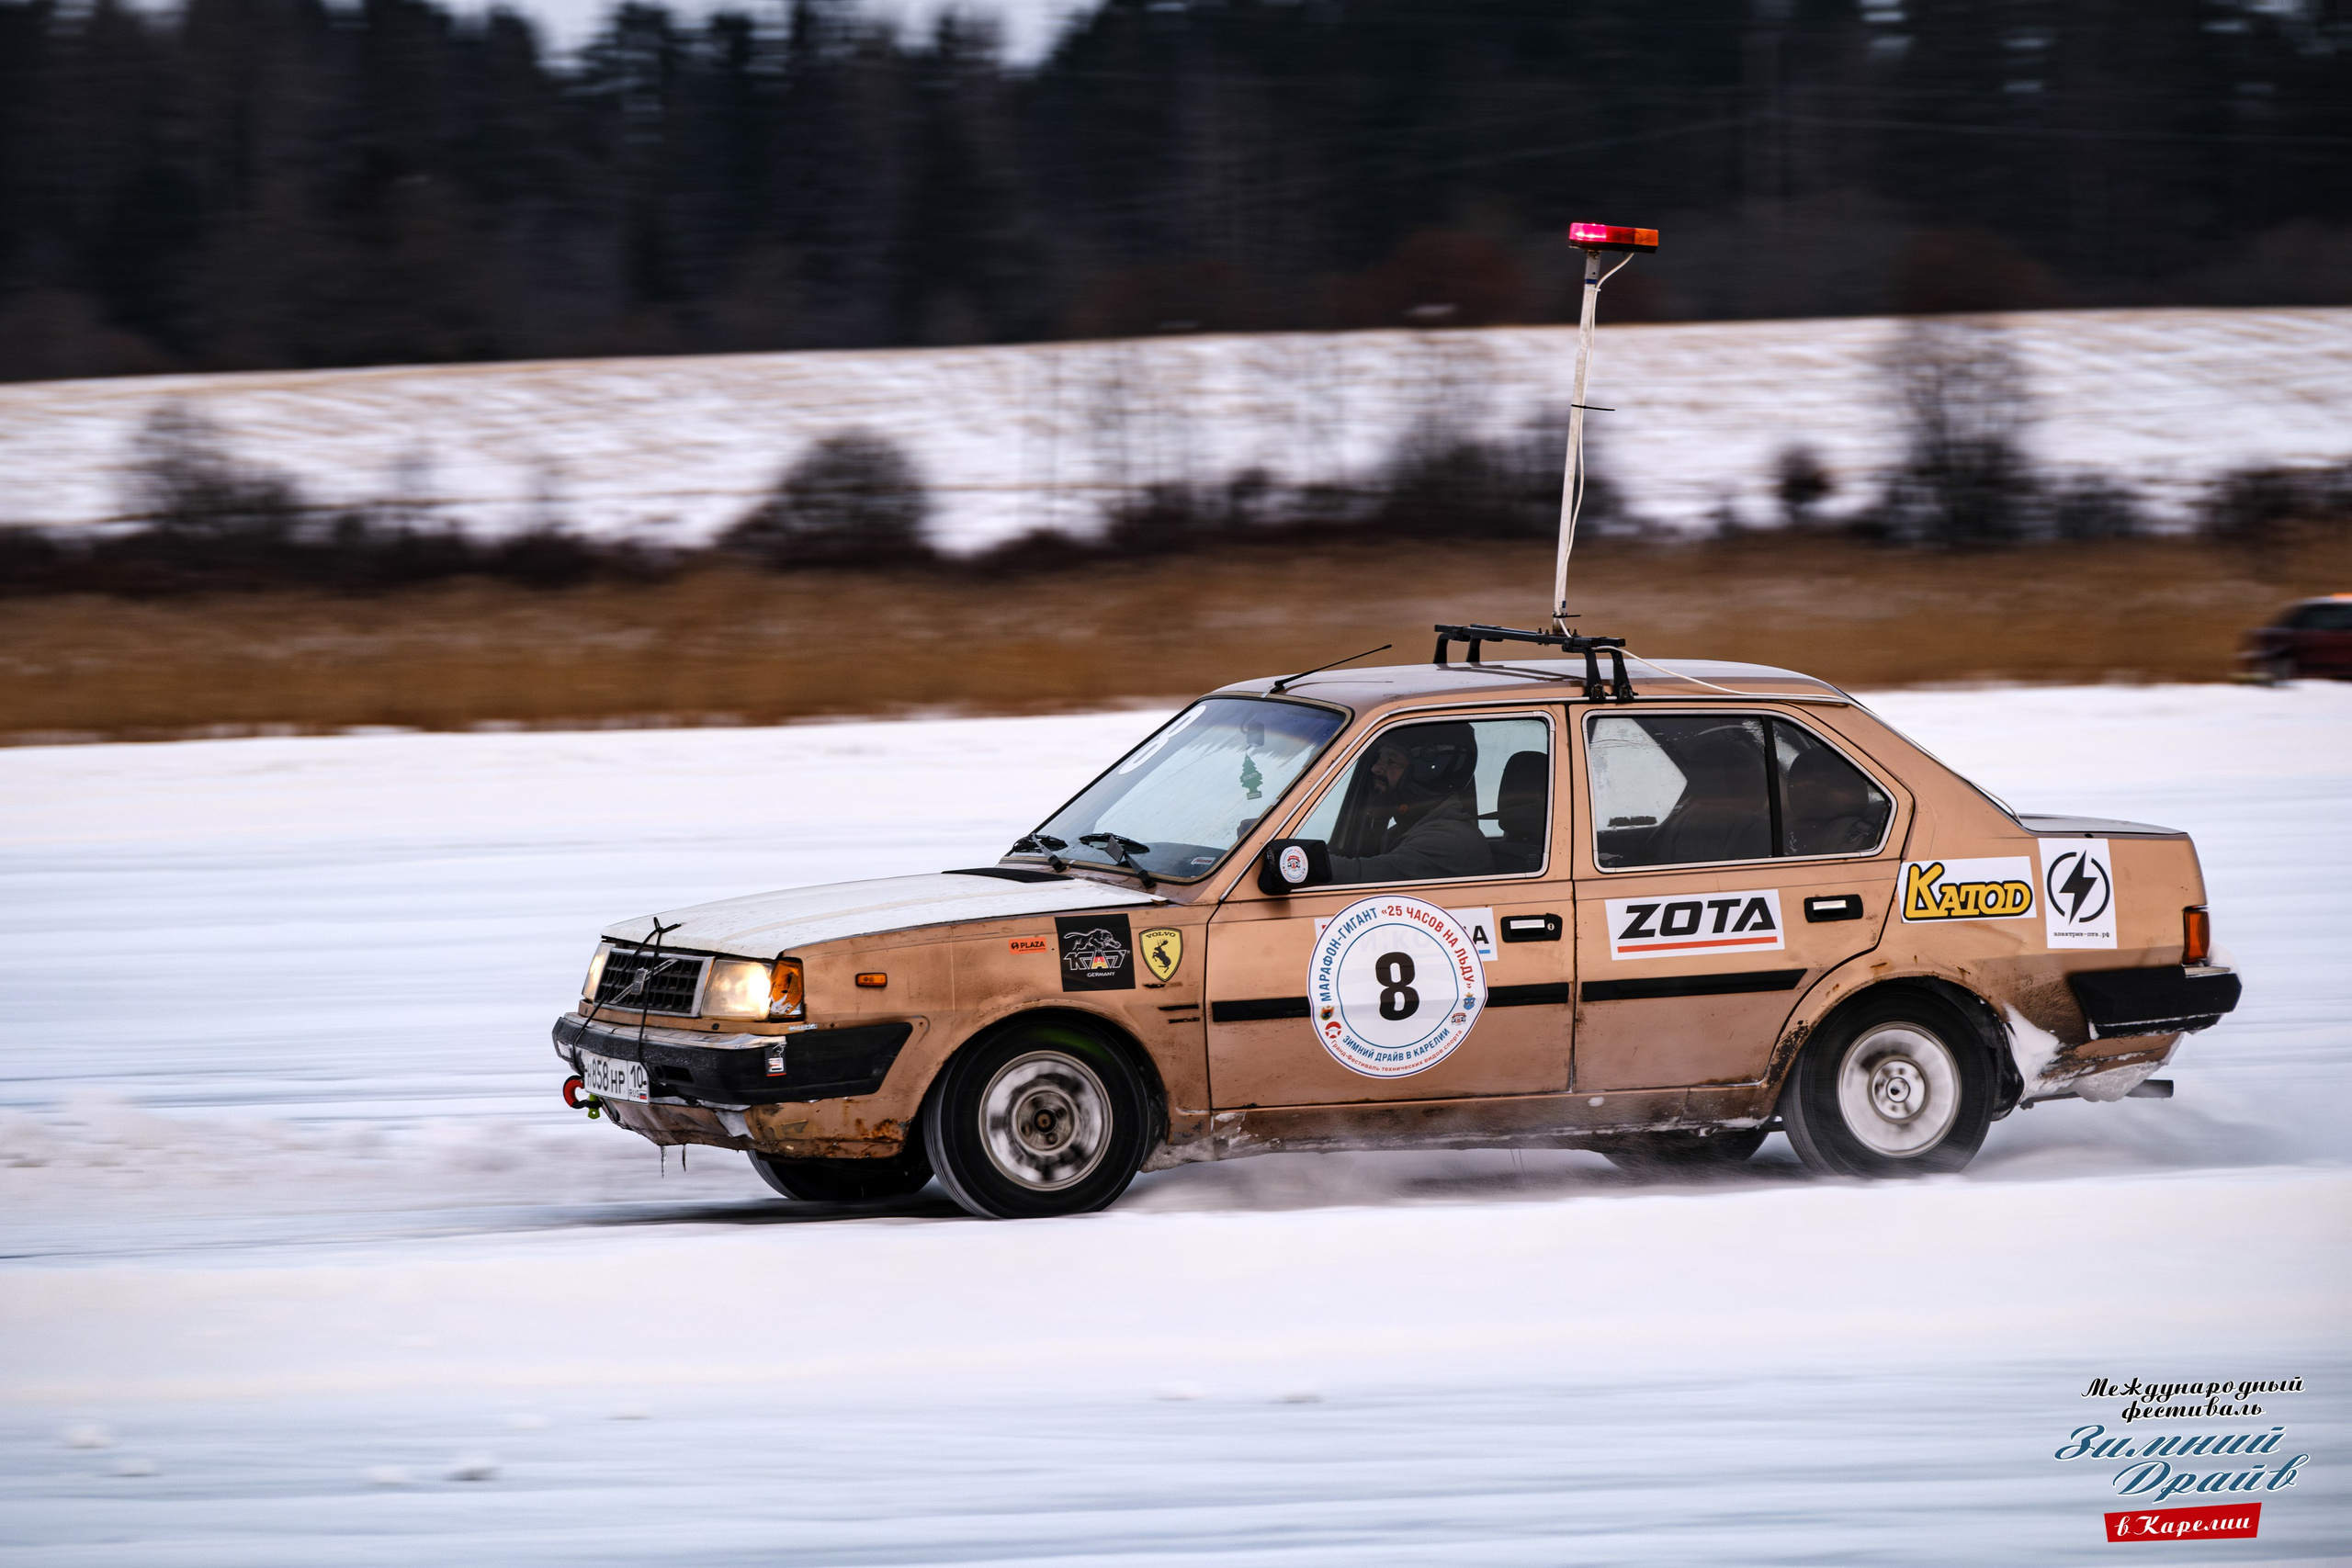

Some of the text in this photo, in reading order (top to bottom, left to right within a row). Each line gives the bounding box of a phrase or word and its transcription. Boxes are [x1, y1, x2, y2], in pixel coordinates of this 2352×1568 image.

[1618, 897, 1776, 940] ZOTA
[1318, 907, 1378, 1002] МАРАФОН-ГИГАНТ
[1406, 907, 1445, 932] ЧАСОВ
[1442, 930, 1458, 948] НА
[1375, 952, 1419, 1021] 8
[1342, 1027, 1451, 1062] ЗИМНИЙ ДРАЙВ В КАРЕЛИИ
[1381, 1060, 1424, 1072] технических
[1424, 1048, 1444, 1064] видов
[1443, 1029, 1464, 1050] спорта
[630, 1065, 644, 1089] 10
